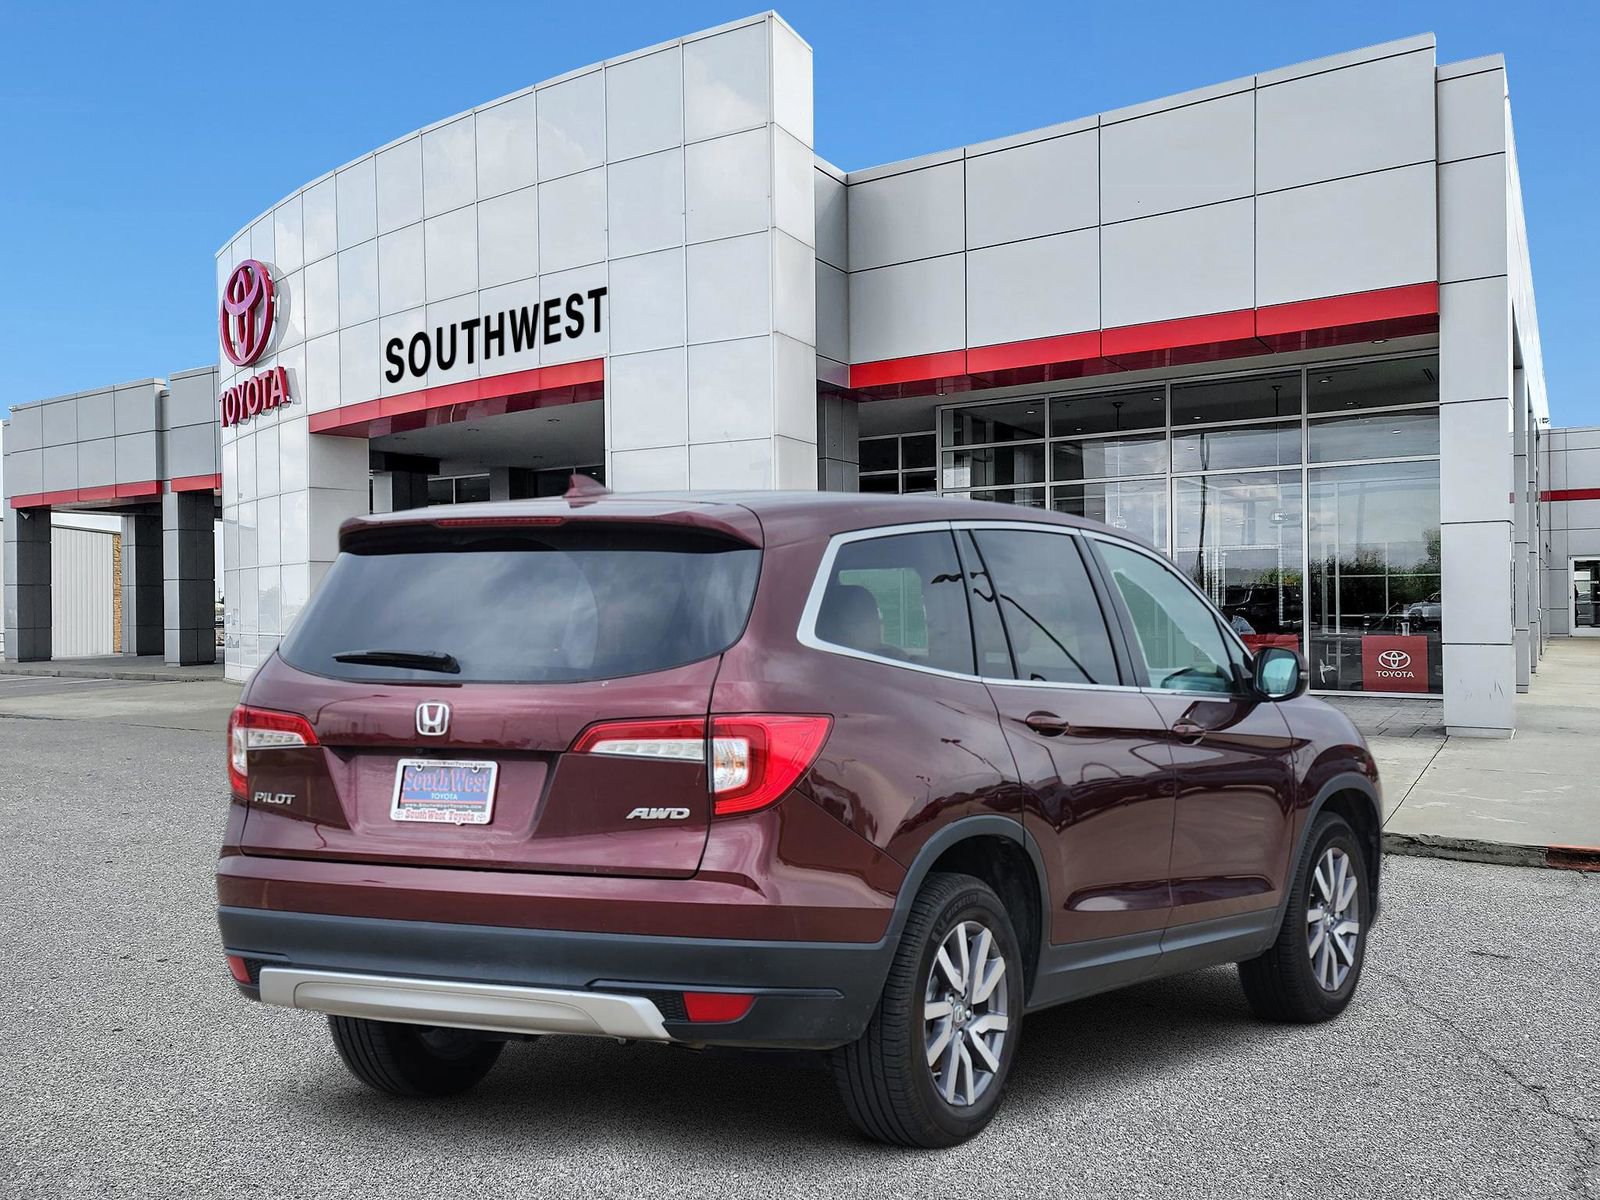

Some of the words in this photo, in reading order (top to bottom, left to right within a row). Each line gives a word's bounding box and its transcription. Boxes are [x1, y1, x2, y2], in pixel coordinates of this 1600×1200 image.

[385, 286, 608, 384] SOUTHWEST
[219, 366, 290, 428] TOYOTA
[1376, 670, 1414, 678] TOYOTA
[254, 791, 296, 805] PILOT
[431, 792, 458, 800] TOYOTA
[449, 810, 475, 823] Toyota
[625, 807, 691, 820] AWD
